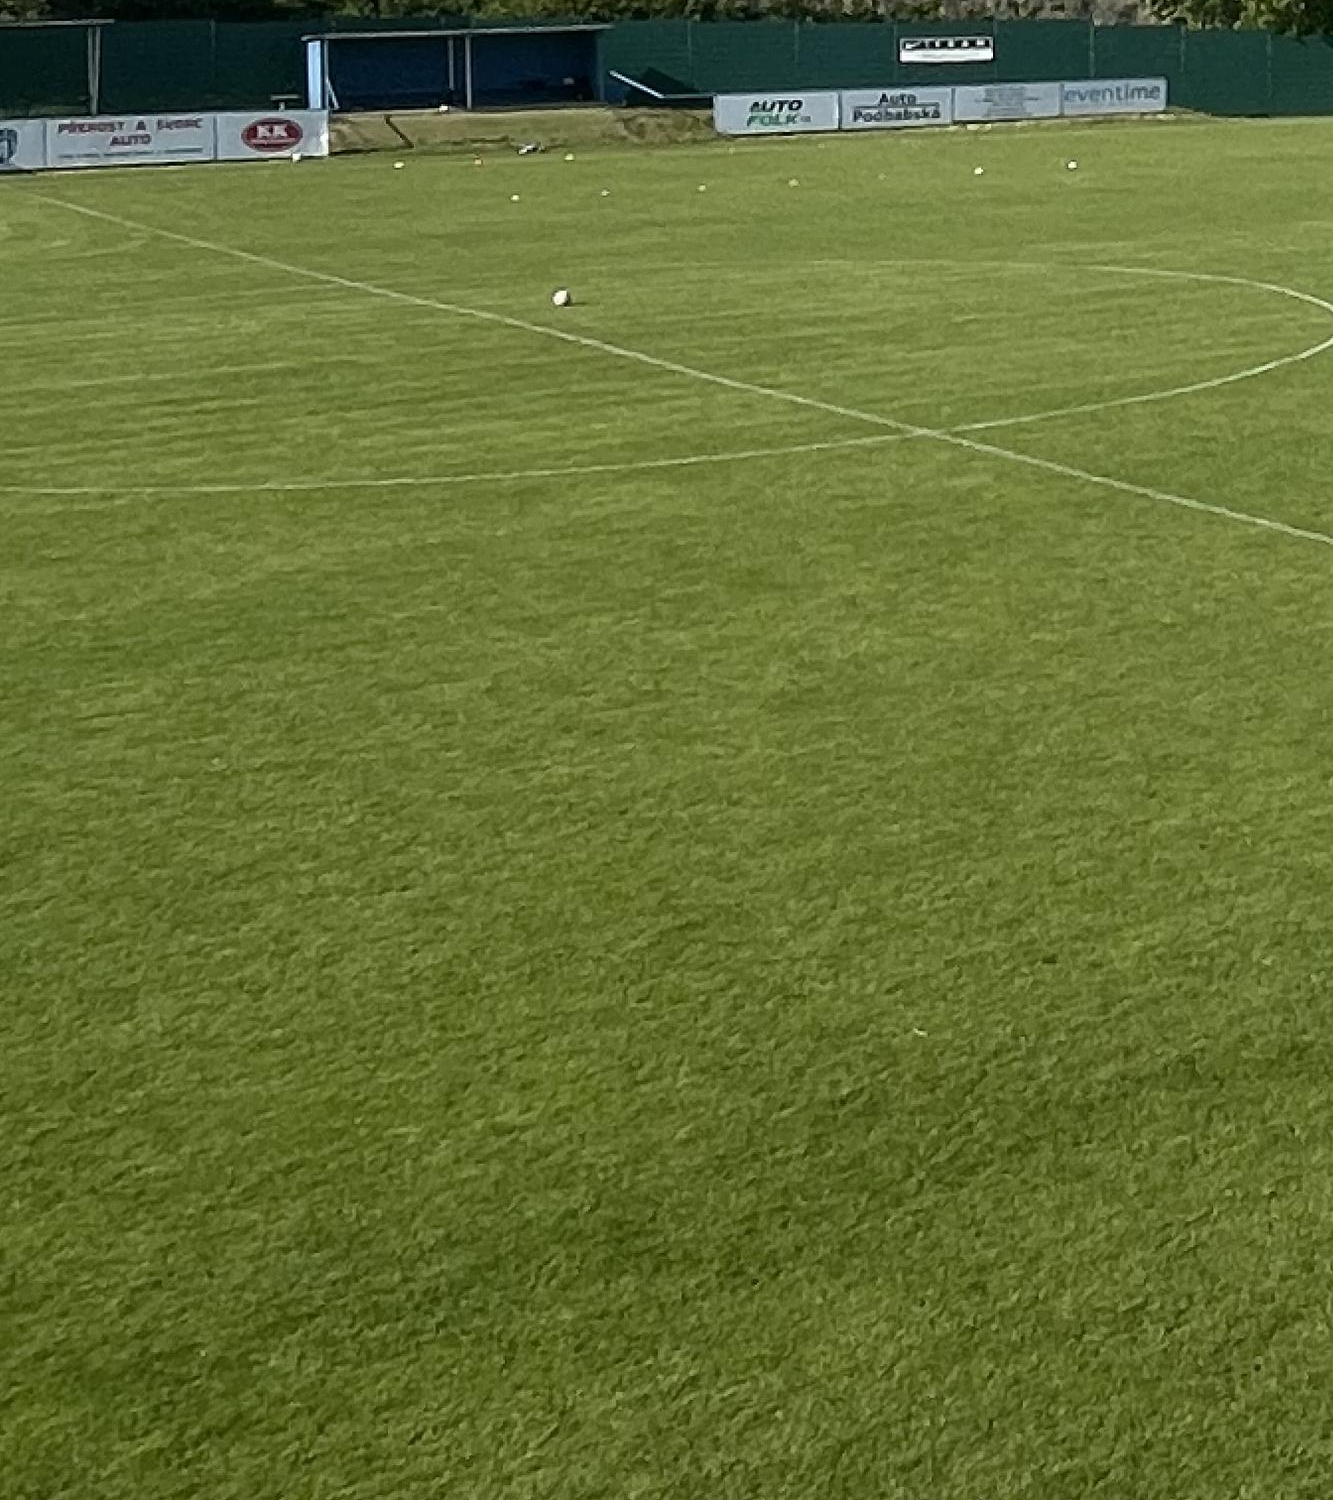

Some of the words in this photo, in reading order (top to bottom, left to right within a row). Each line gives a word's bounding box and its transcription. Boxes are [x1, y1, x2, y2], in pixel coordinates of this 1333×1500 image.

[878, 93, 917, 106] Auto
[1064, 84, 1161, 102] eventime
[750, 99, 803, 112] AUTO
[110, 134, 152, 146] AUTO
